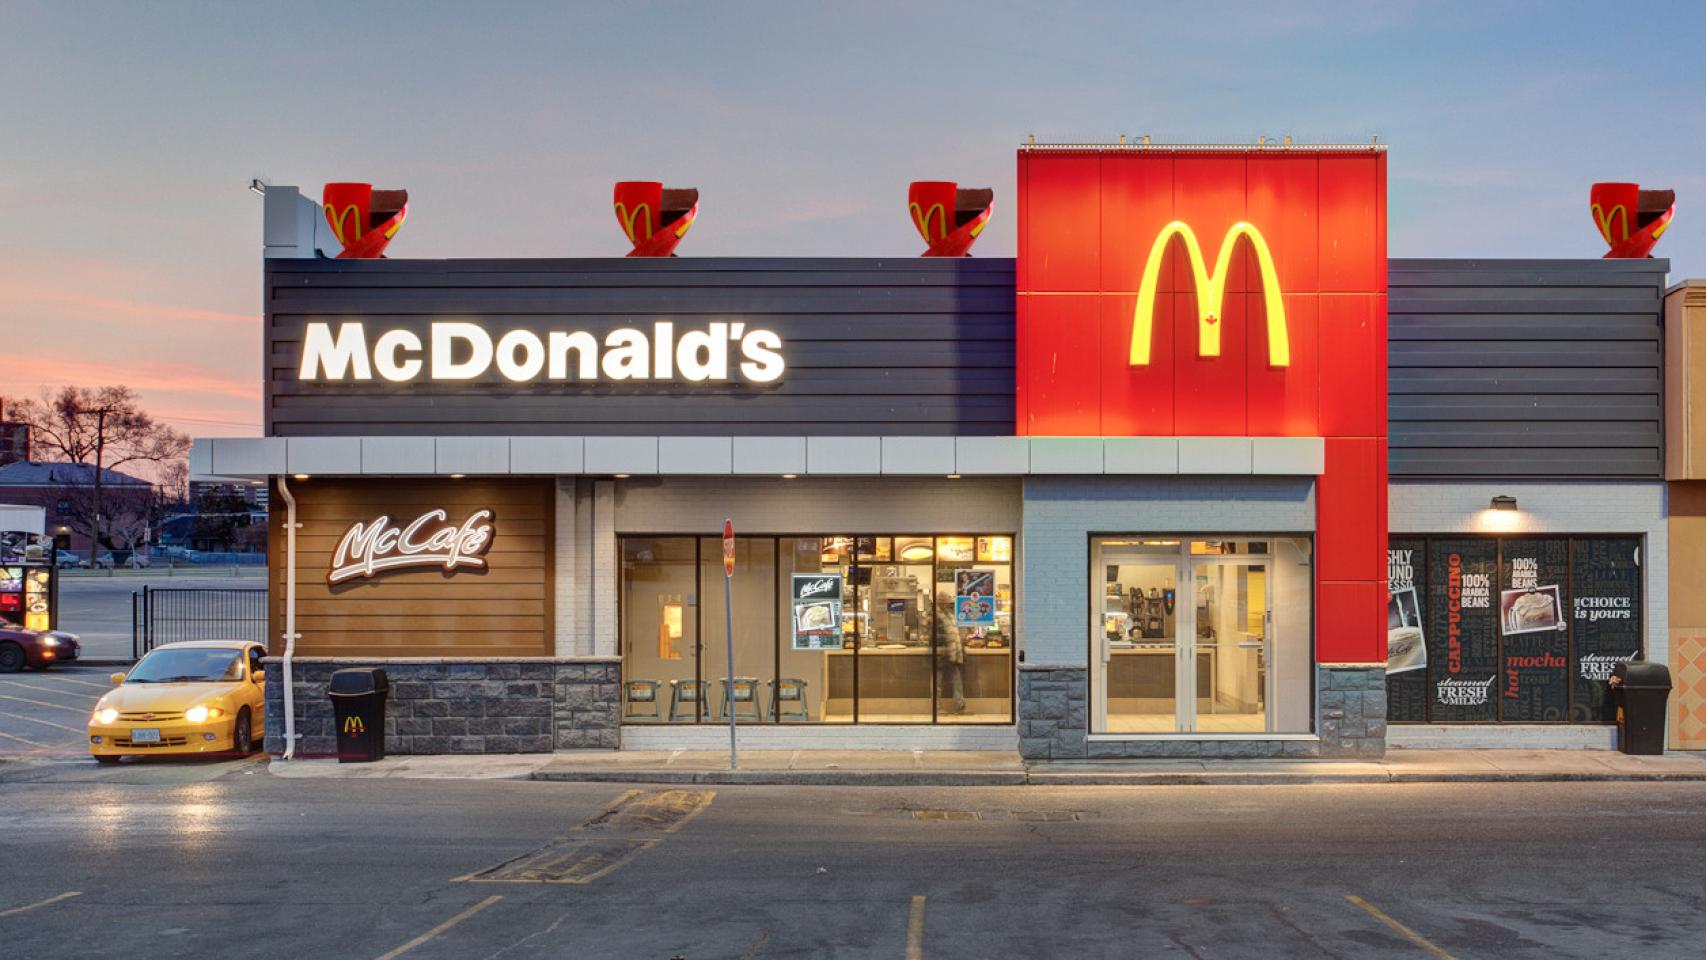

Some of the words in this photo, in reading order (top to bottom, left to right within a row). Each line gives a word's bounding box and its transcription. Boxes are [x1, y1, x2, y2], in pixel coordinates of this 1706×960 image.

[299, 321, 786, 382] McDonald's
[333, 508, 490, 574] McCafé
[1512, 557, 1538, 570] 100%
[1461, 573, 1490, 588] 100%
[1511, 577, 1538, 589] BEANS
[1461, 587, 1490, 598] ARABICA
[1461, 597, 1490, 608] BEANS
[1580, 596, 1631, 608] CHOICE
[1448, 553, 1461, 673] CAPPUCCINO
[1575, 606, 1588, 619] is
[1589, 609, 1631, 622] yours
[1506, 651, 1567, 668] mocha
[1580, 662, 1617, 673] FRES
[1504, 669, 1520, 699] hot
[1437, 686, 1488, 698] FRESH
[1449, 697, 1478, 706] MILK
